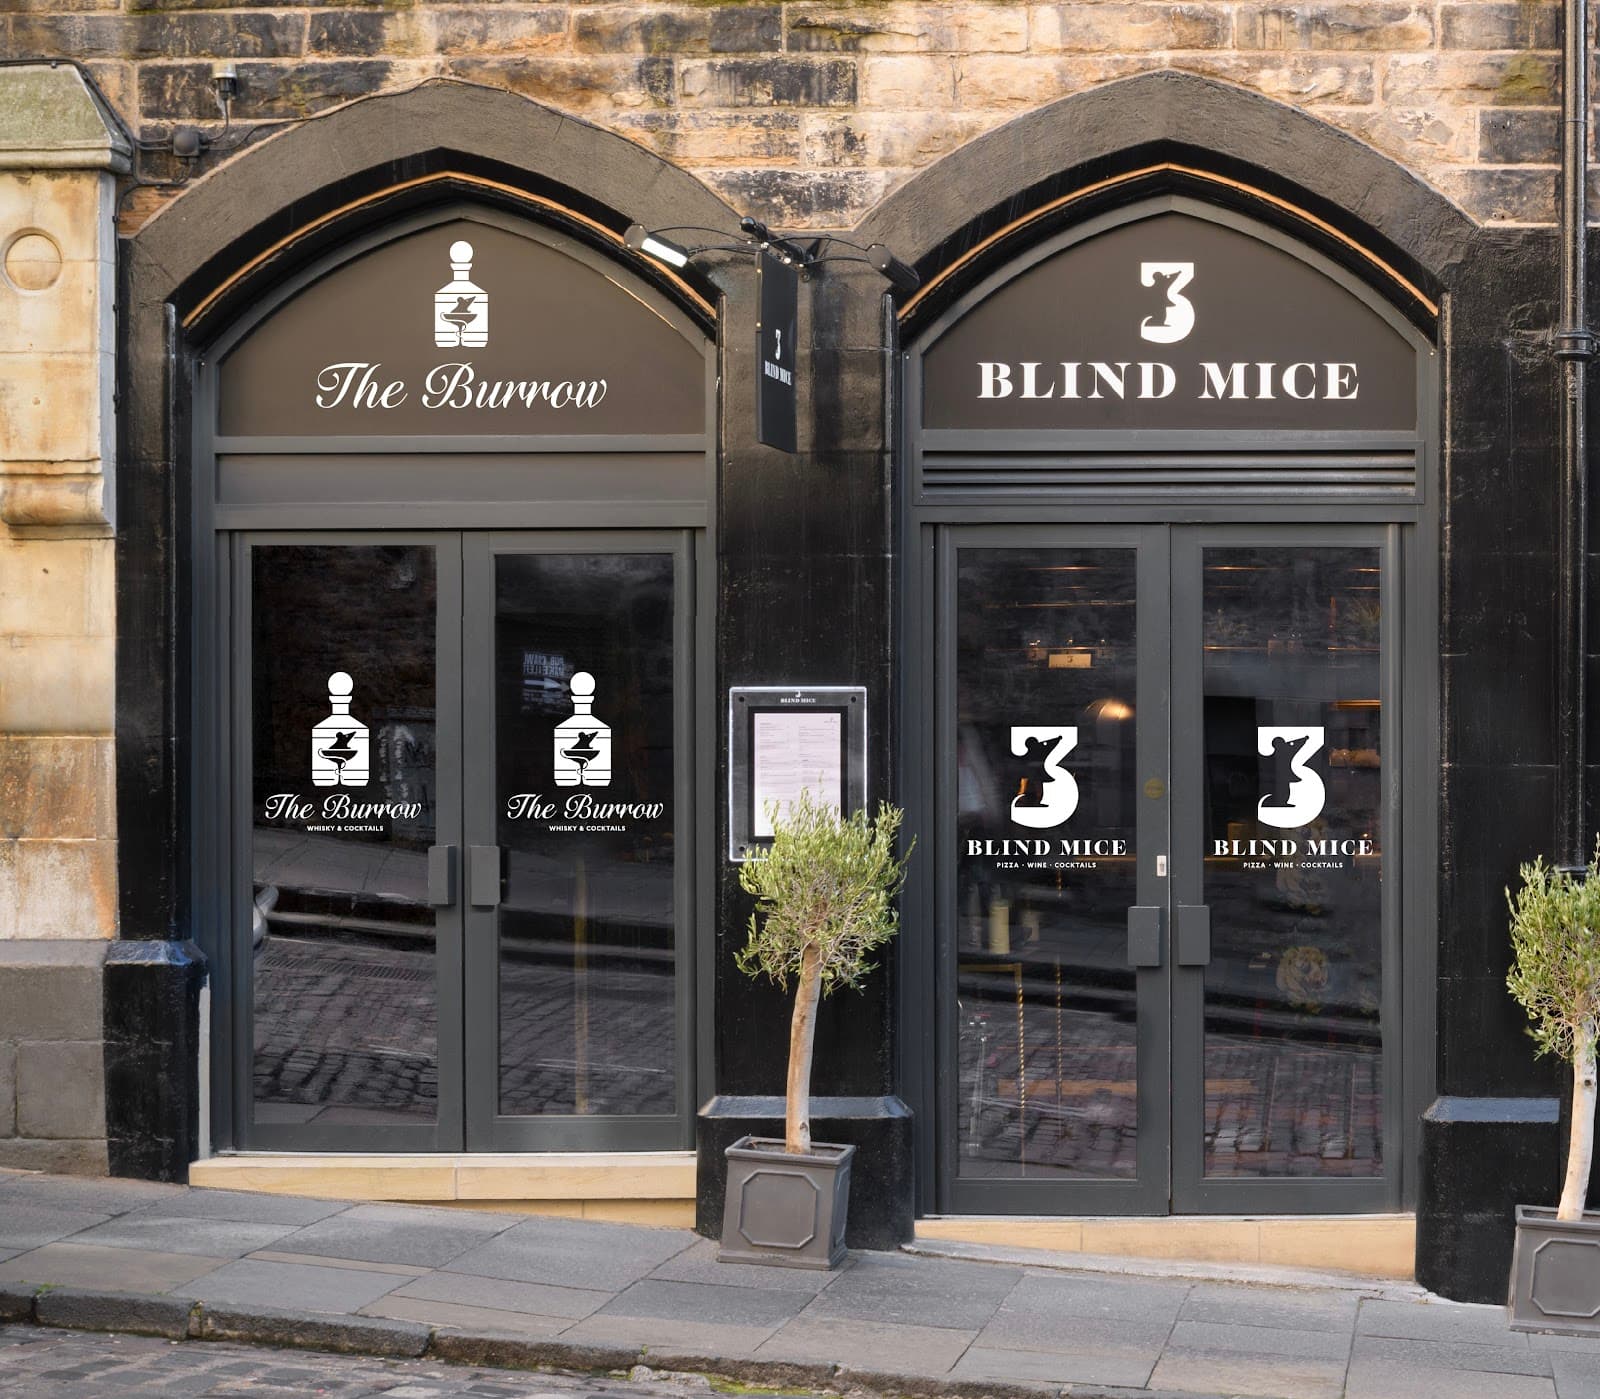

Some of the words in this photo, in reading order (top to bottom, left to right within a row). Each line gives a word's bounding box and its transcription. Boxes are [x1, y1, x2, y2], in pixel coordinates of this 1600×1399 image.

[1140, 261, 1195, 344] 3
[315, 362, 407, 409] The
[421, 361, 608, 409] Burrow
[764, 360, 779, 380] BLIND
[779, 367, 792, 386] MICE
[977, 362, 1177, 400] BLIND
[1197, 362, 1359, 400] MICE
[1010, 726, 1079, 828] 3
[1257, 726, 1326, 828] 3
[265, 793, 314, 820] The
[321, 793, 422, 820] Burrow
[507, 793, 556, 820] The
[563, 793, 664, 820] Burrow
[967, 839, 1051, 856] BLIND
[1059, 839, 1127, 856] MICE
[1214, 839, 1297, 856] BLIND
[1306, 839, 1373, 856] MICE
[996, 861, 1020, 869] PIZZA
[1026, 861, 1047, 869] WINE
[1054, 861, 1097, 869] COCKTAILS
[1243, 861, 1266, 869] PIZZA
[1273, 861, 1294, 869] WINE
[1301, 861, 1344, 869] COCKTAILS
